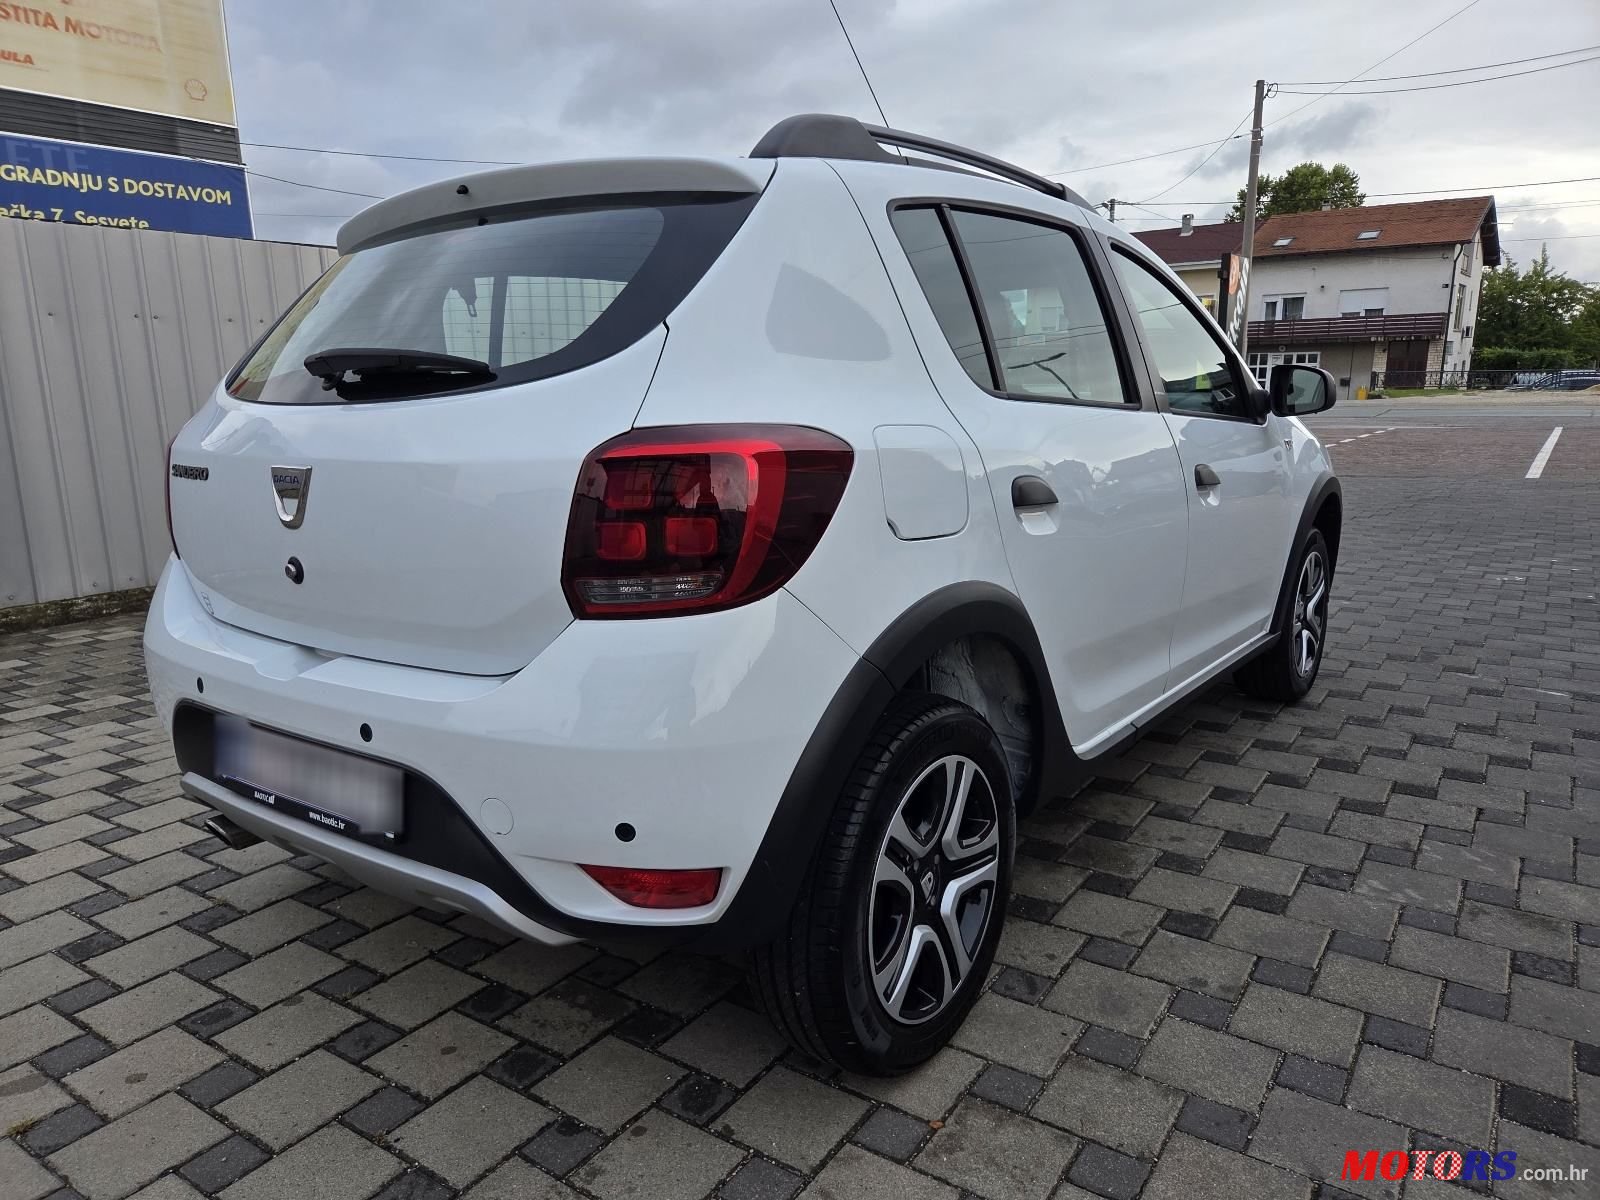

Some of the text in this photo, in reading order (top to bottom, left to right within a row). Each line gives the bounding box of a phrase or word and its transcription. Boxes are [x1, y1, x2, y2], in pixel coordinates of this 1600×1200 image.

[107, 176, 119, 193] S
[123, 178, 232, 206] DOSTAVOM
[171, 463, 209, 481] SANDERO
[273, 474, 300, 485] DACIA
